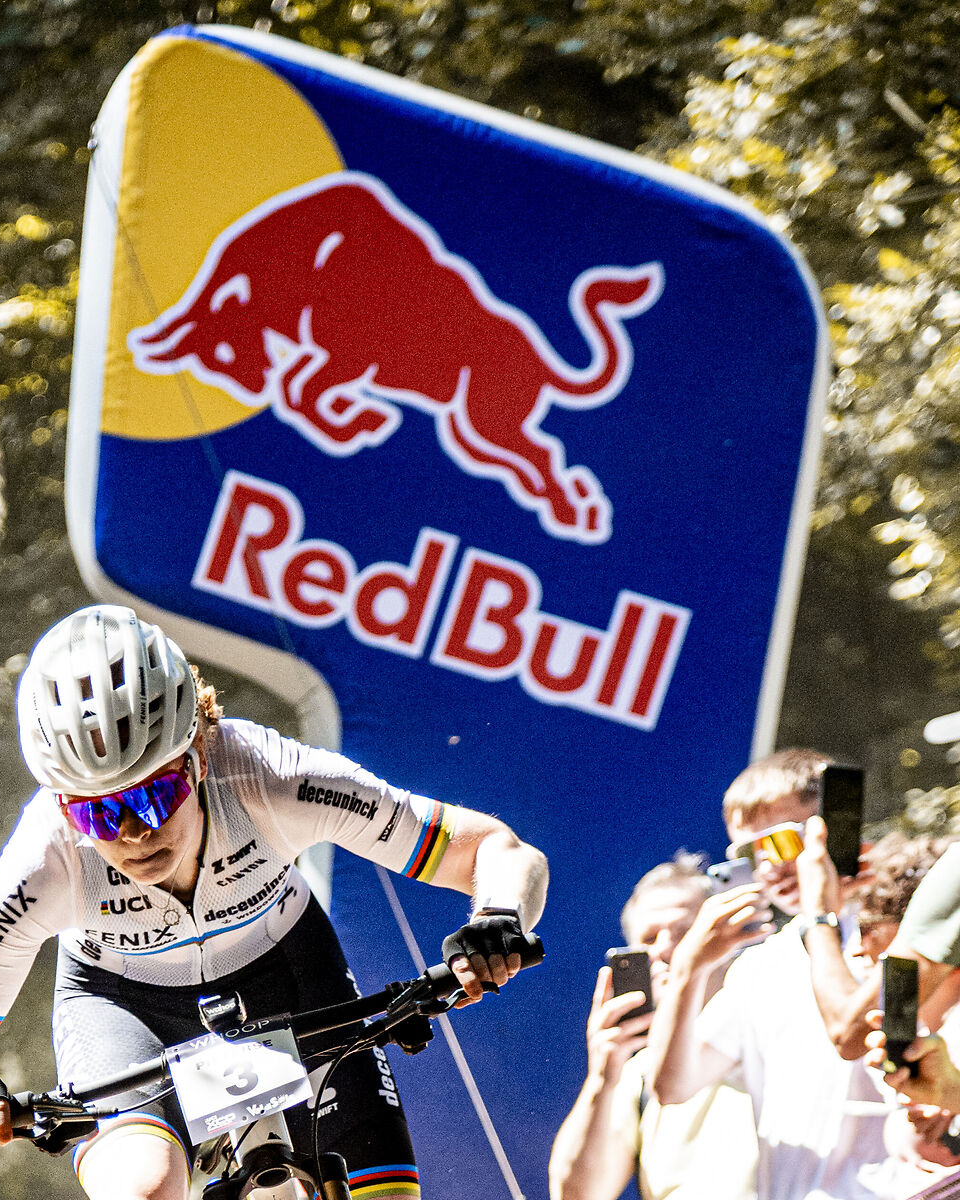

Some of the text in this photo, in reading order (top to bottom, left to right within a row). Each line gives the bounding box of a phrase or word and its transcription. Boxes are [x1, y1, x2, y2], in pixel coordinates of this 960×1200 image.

[297, 779, 379, 821] deceuninck
[217, 858, 268, 887] CANYON
[109, 895, 153, 915] UCI
[204, 863, 291, 922] deceuninck
[206, 1002, 236, 1015] wahoo
[223, 1062, 259, 1096] 3
